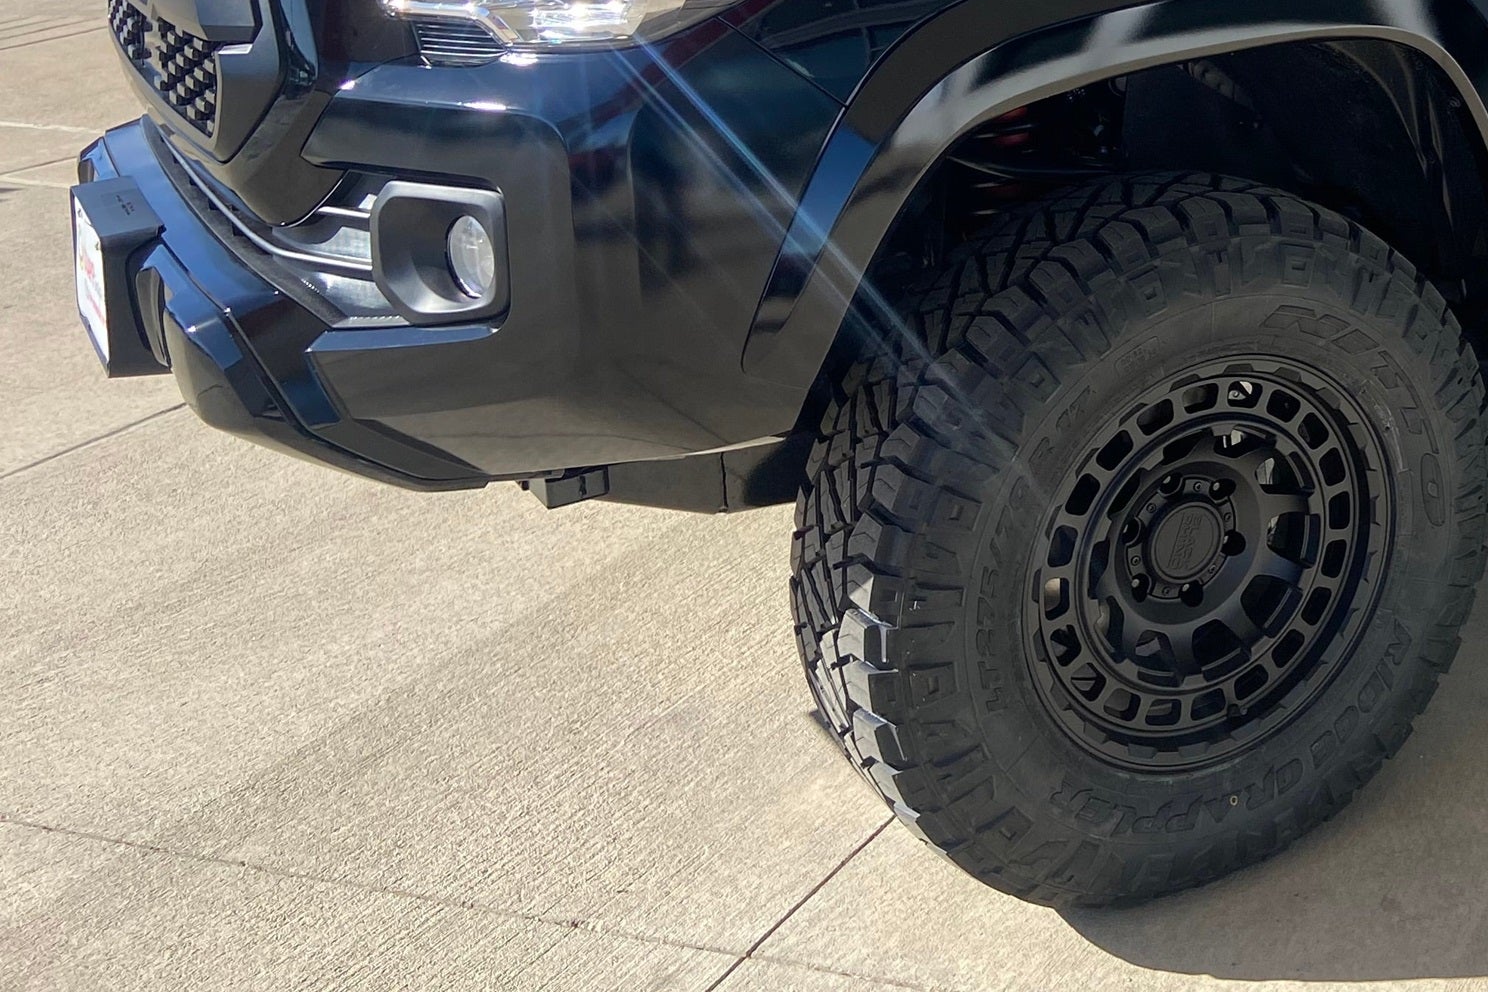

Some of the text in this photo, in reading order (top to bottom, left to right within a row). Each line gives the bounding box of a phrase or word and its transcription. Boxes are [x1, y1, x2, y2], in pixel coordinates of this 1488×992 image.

[1258, 304, 1446, 527] NITTO
[1049, 616, 1412, 835] RIDGE GRAPPLER
